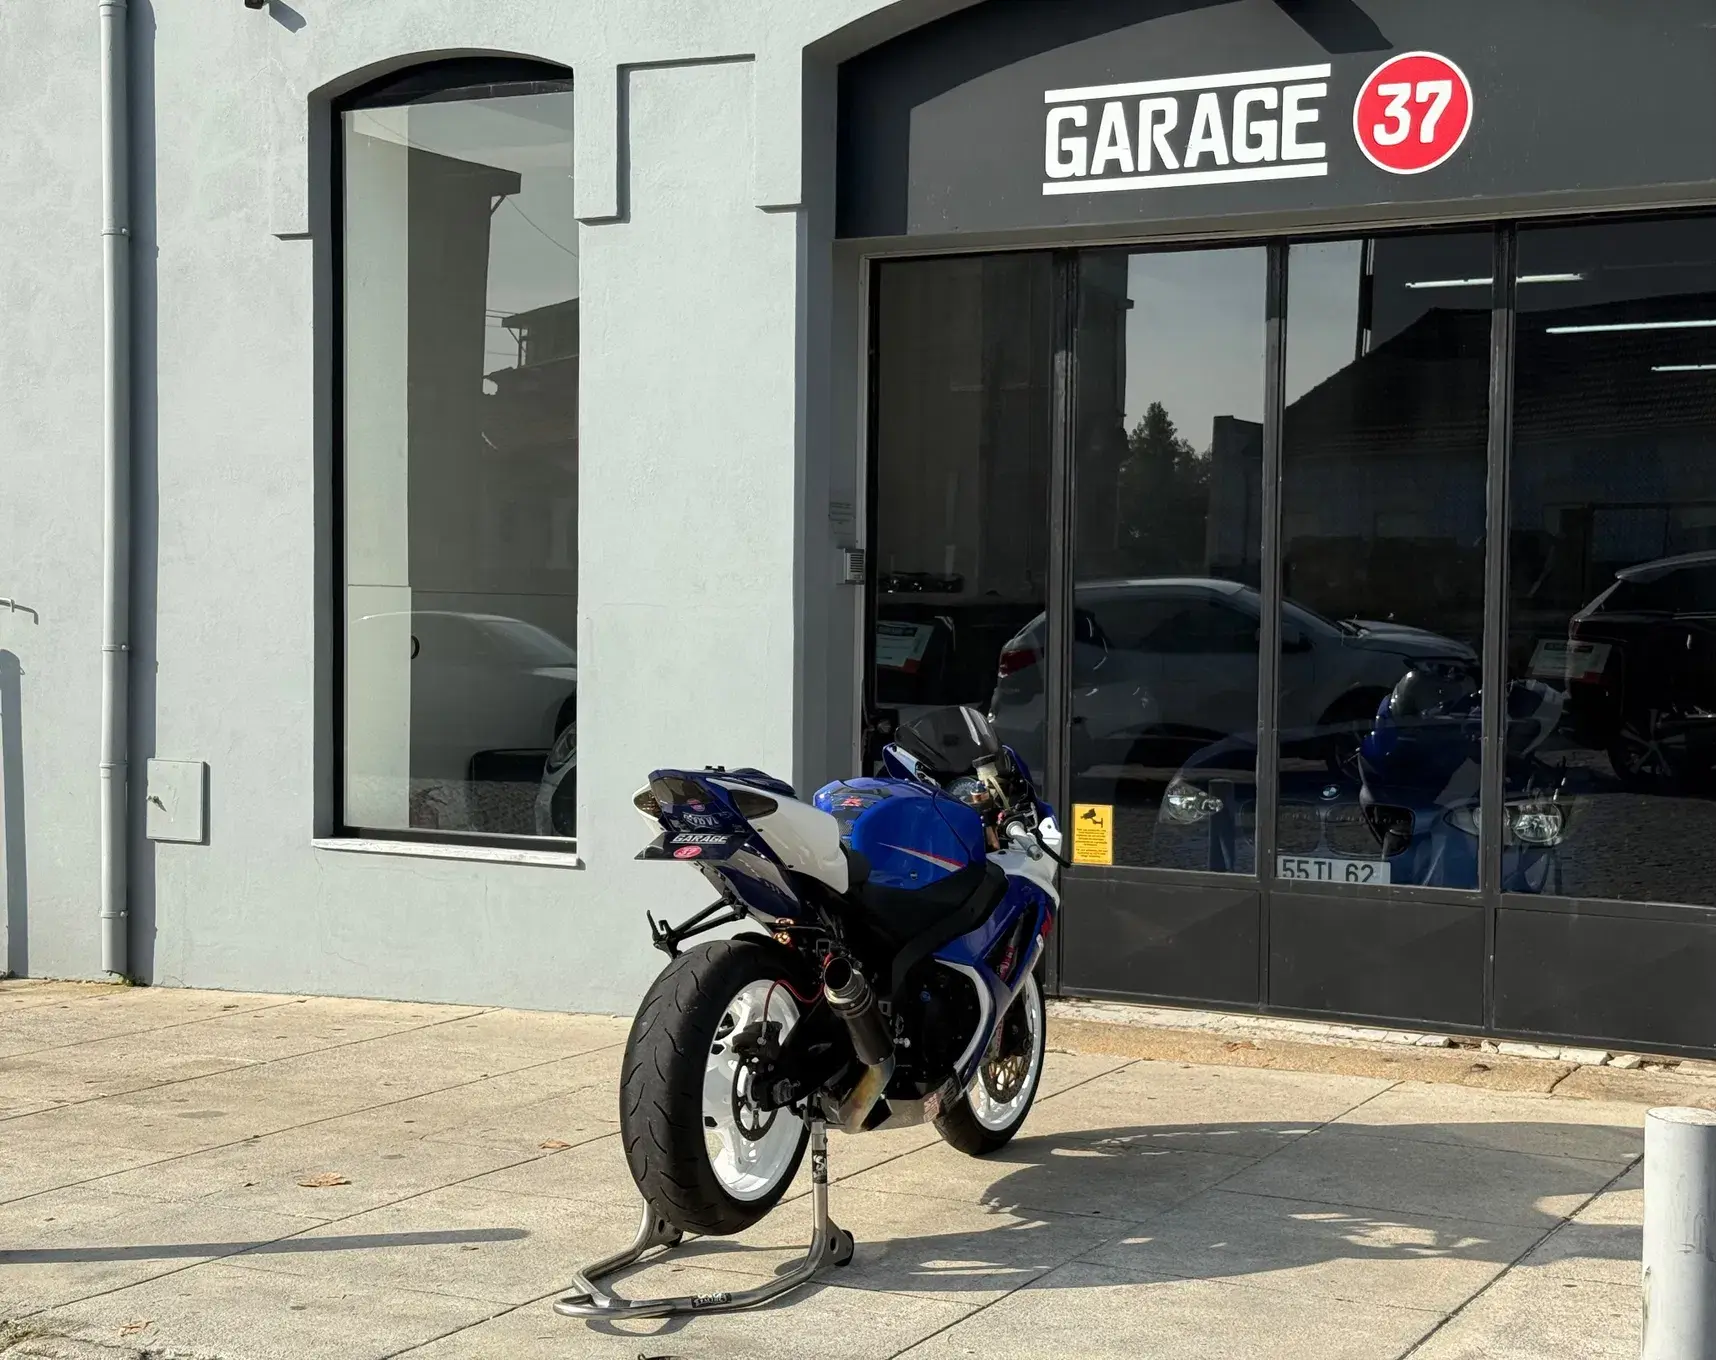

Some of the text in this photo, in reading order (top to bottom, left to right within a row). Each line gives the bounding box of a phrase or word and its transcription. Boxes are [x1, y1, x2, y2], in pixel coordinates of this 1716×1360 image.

[1045, 80, 1452, 178] GARAGE 37
[672, 834, 728, 843] GARAGE
[1282, 859, 1309, 879] 55
[1346, 863, 1374, 882] 62
